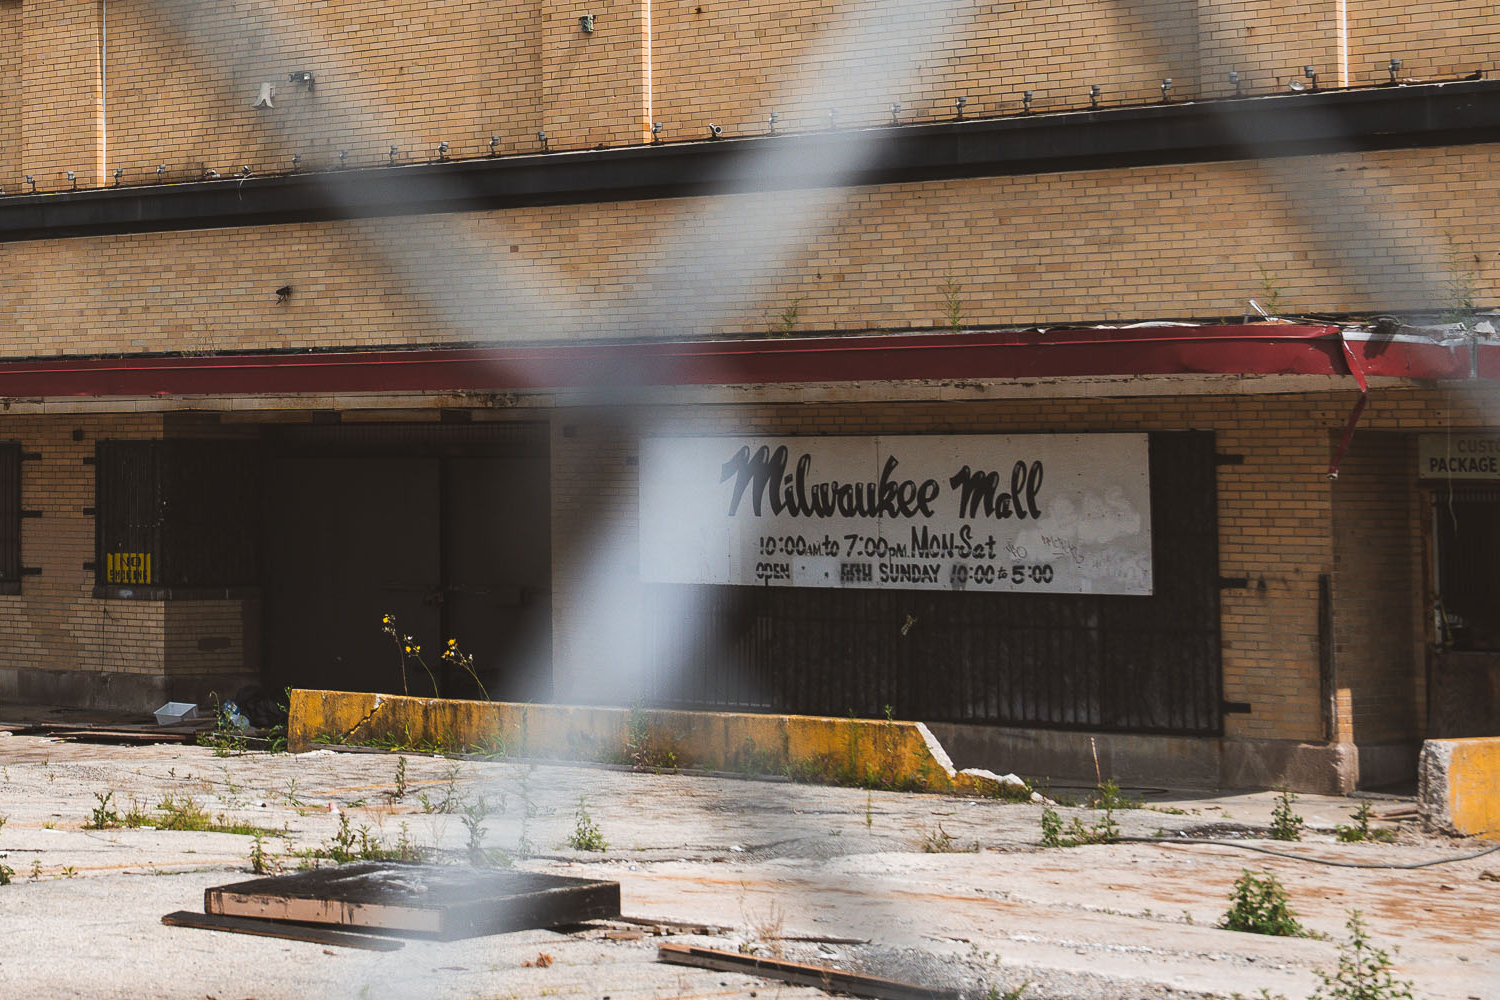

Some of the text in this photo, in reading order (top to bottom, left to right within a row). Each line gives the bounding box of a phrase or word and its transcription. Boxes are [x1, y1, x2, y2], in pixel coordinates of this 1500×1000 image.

[1429, 456, 1498, 473] PACKAGE
[719, 445, 1044, 520] Milwaukee Mall
[822, 534, 840, 558] to
[879, 562, 941, 584] SUNDAY
[950, 563, 995, 585] 10:00
[997, 567, 1009, 580] to
[1011, 563, 1054, 585] 5:00
